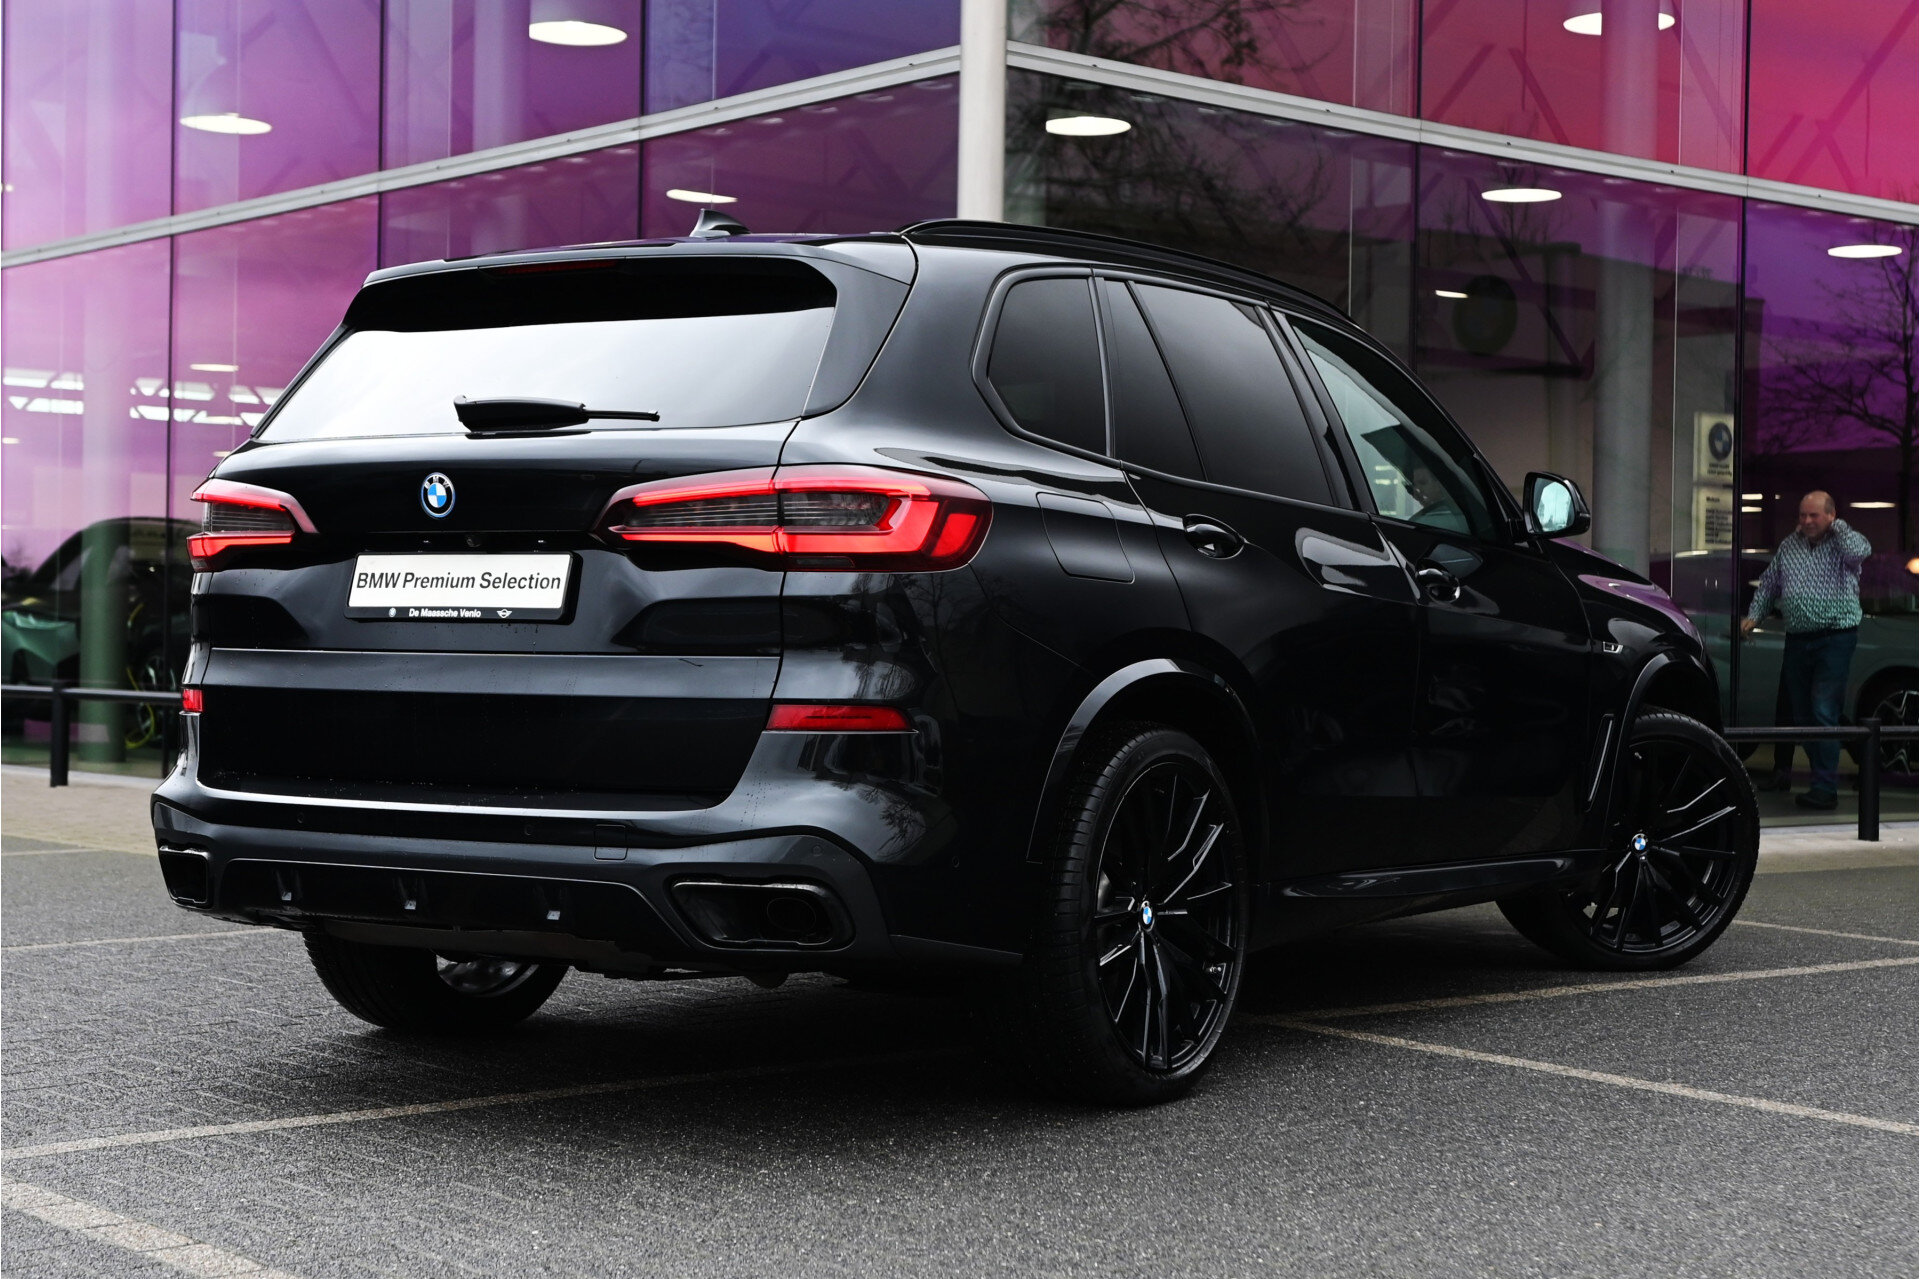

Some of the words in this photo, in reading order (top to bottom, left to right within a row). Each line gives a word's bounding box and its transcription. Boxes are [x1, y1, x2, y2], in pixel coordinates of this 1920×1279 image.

[356, 572, 401, 588] BMW
[402, 572, 475, 588] Premium
[479, 572, 560, 589] Selection
[408, 608, 420, 617] De
[420, 608, 458, 617] Maassche
[459, 608, 482, 618] Venlo
